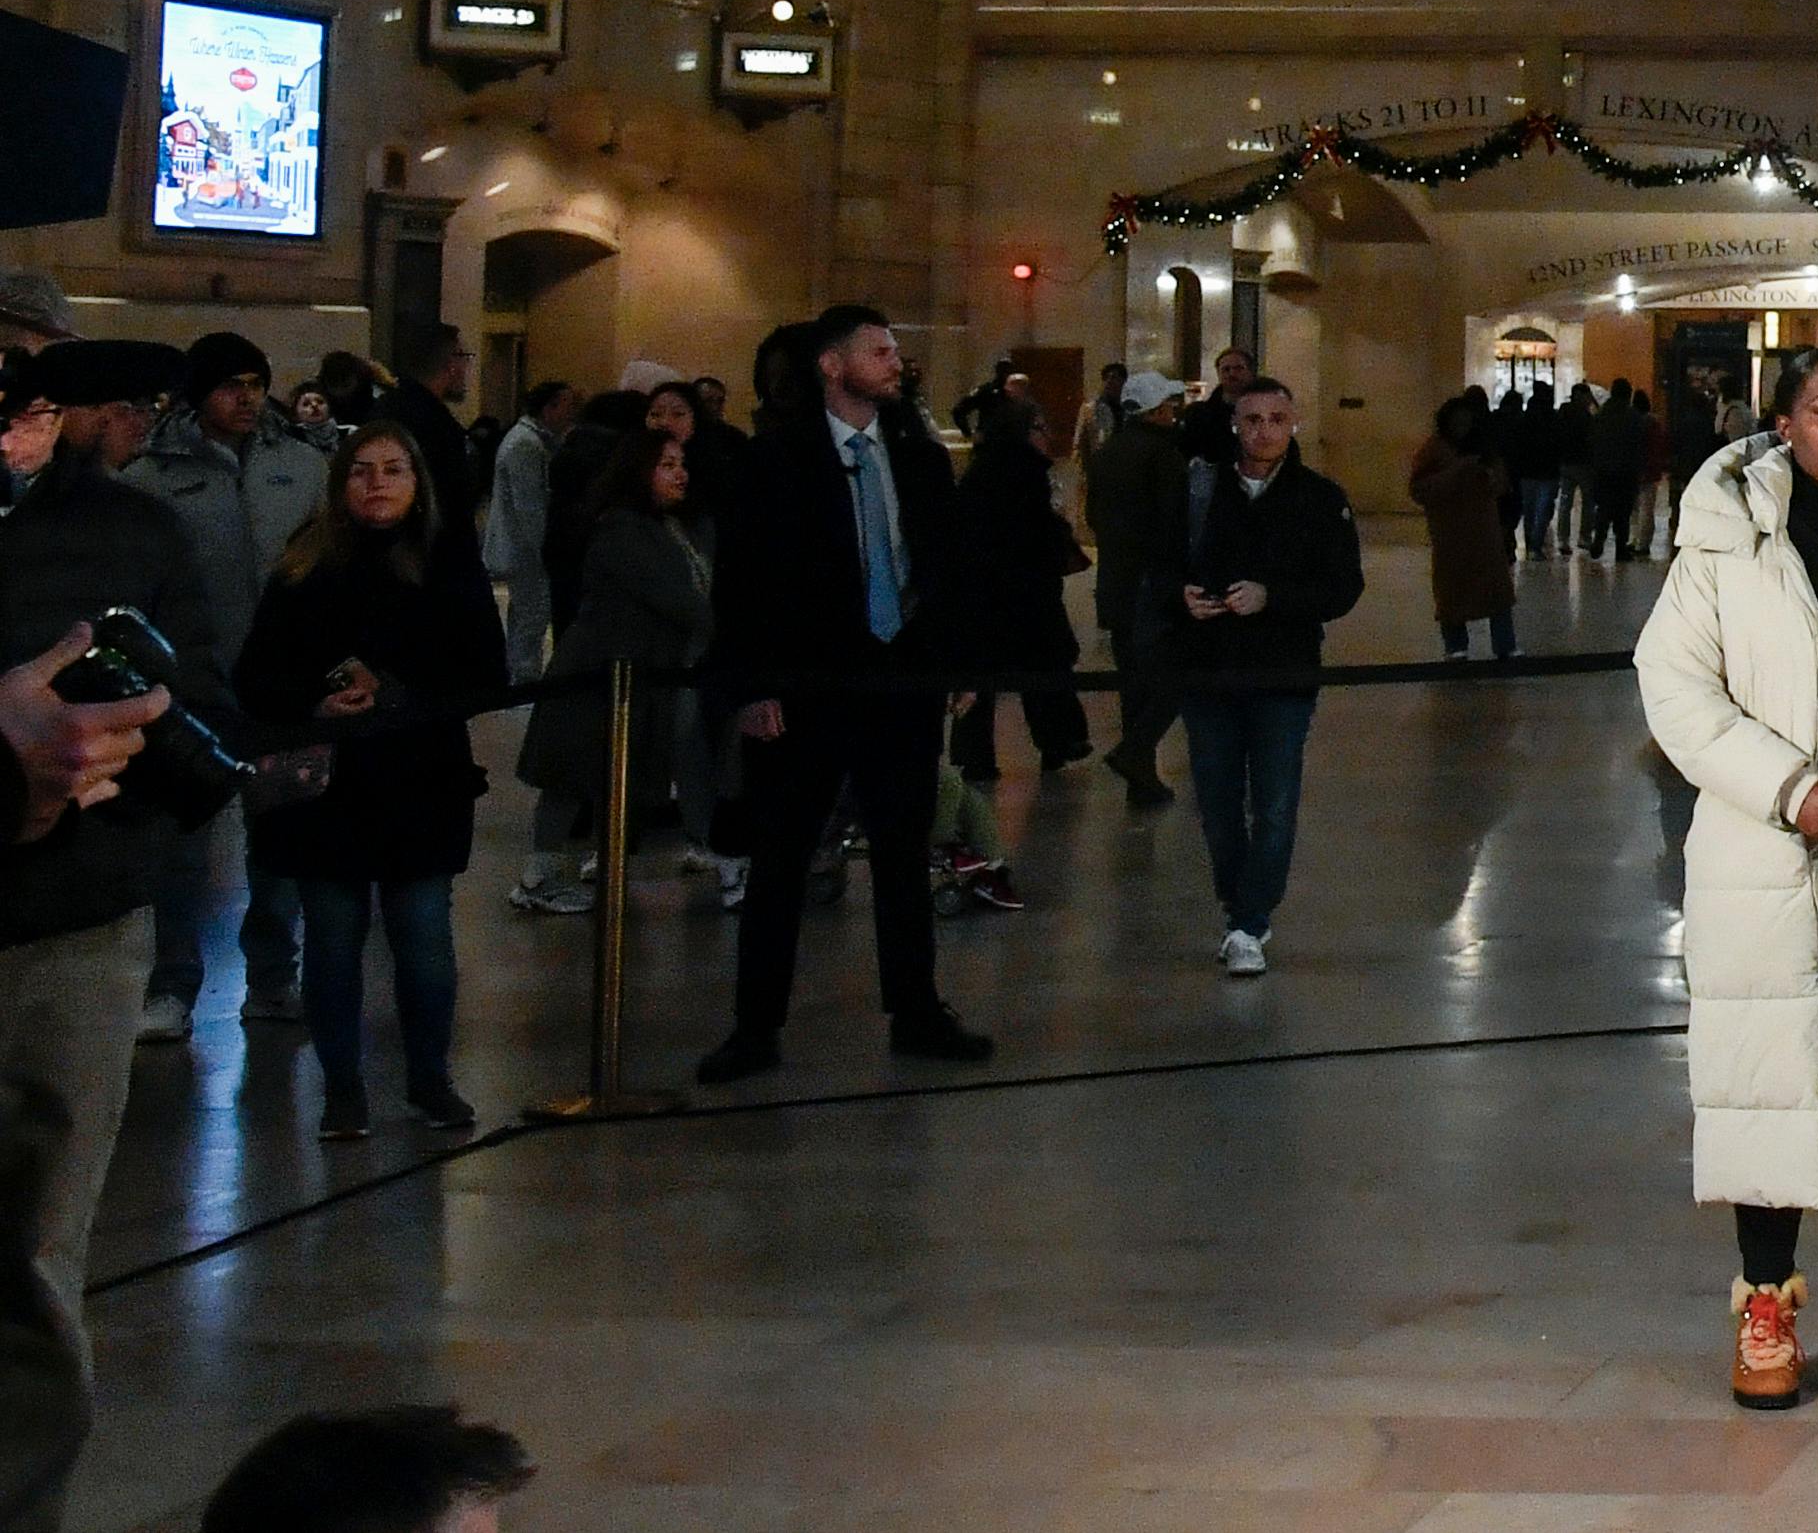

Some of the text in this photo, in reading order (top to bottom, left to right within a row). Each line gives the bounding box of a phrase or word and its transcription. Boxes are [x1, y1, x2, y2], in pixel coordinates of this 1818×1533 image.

[1253, 108, 1373, 148] TRAKS
[1412, 98, 1457, 122] TO
[1601, 95, 1781, 140] LEXINGTON
[1593, 242, 1680, 268] STREET
[1686, 238, 1789, 259] PASSAGE
[1688, 290, 1798, 304] LEXINGTON
